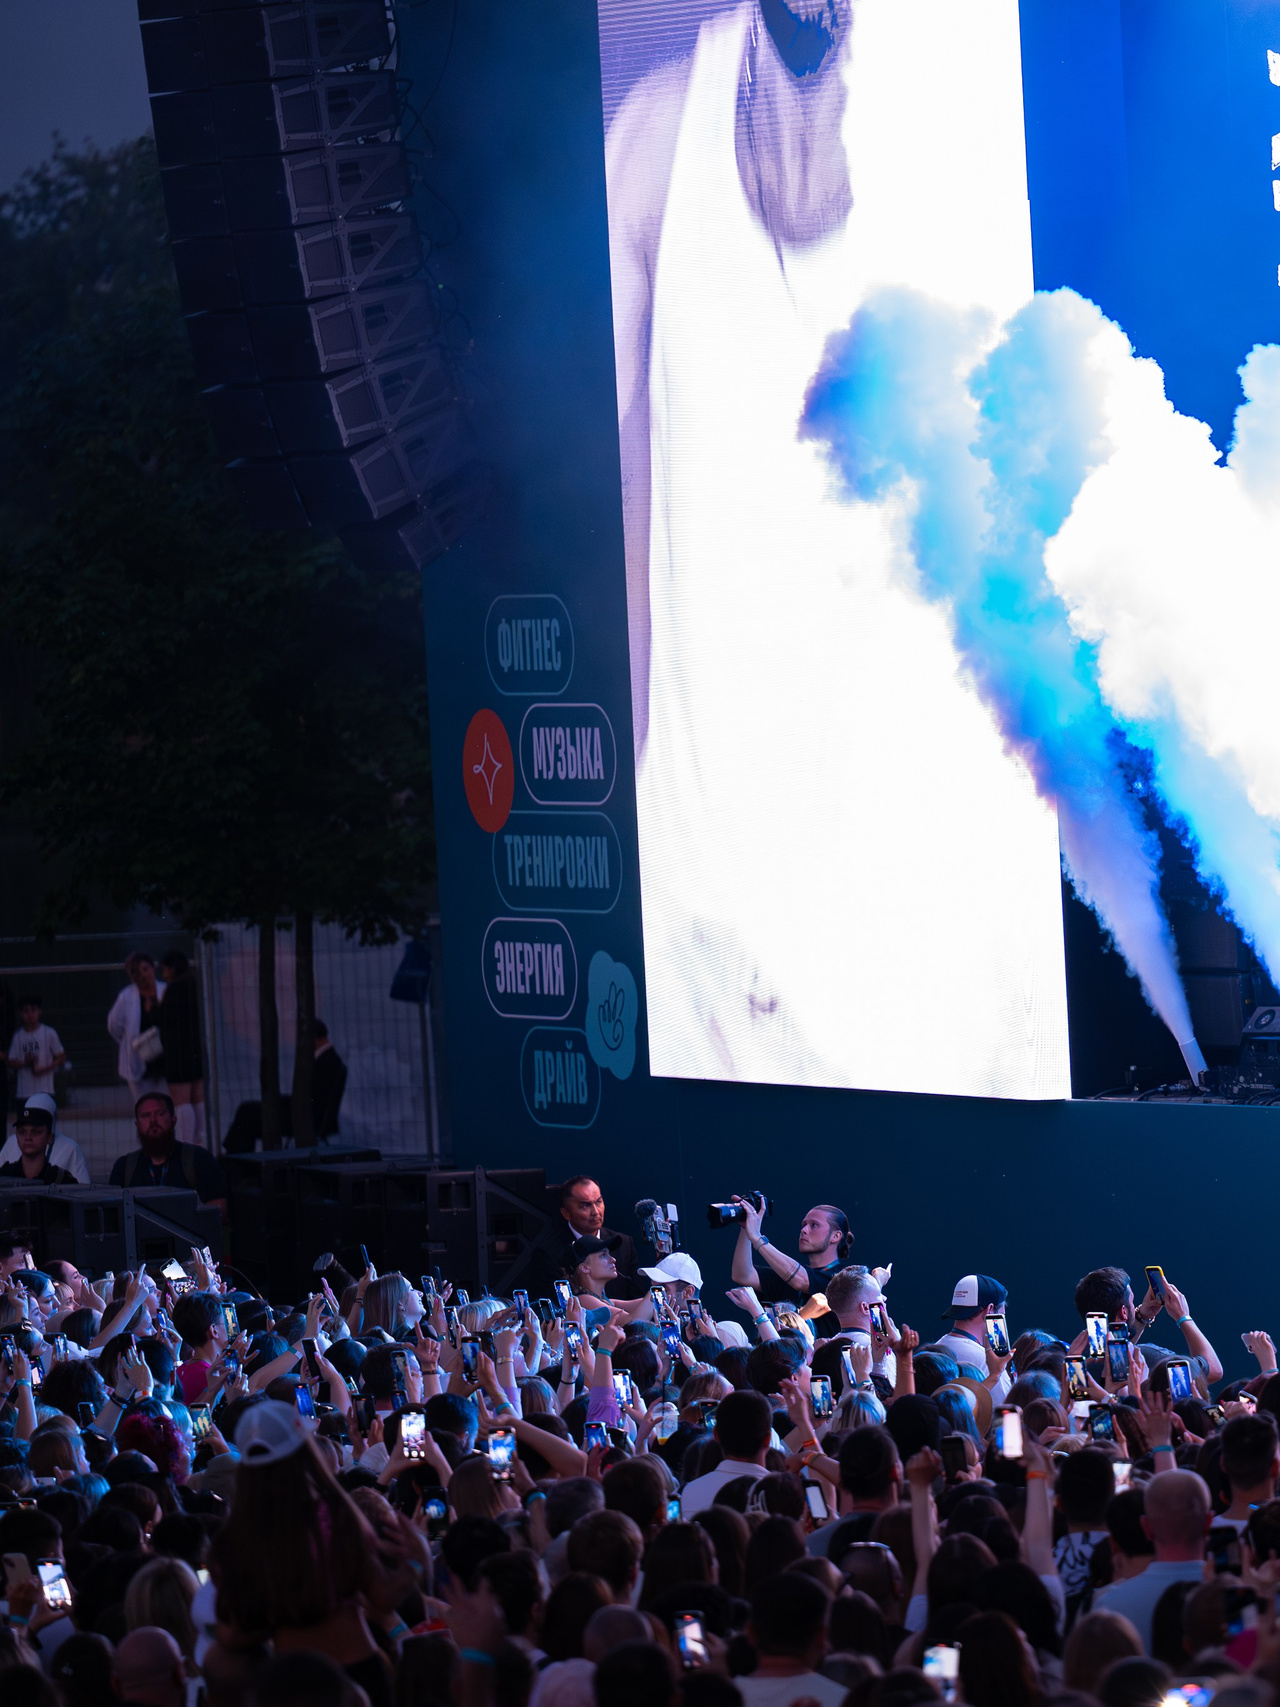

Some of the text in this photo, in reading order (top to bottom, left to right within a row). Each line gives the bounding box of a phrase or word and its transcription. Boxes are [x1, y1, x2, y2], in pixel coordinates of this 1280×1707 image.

[498, 618, 561, 672] ФИТНЕС
[532, 726, 604, 780] МУЗЫКА
[504, 835, 610, 889] ТРЕНИРОВКИ
[494, 940, 565, 996] ЭНЕРГИЯ
[534, 1039, 588, 1110] ДРАЙВ
